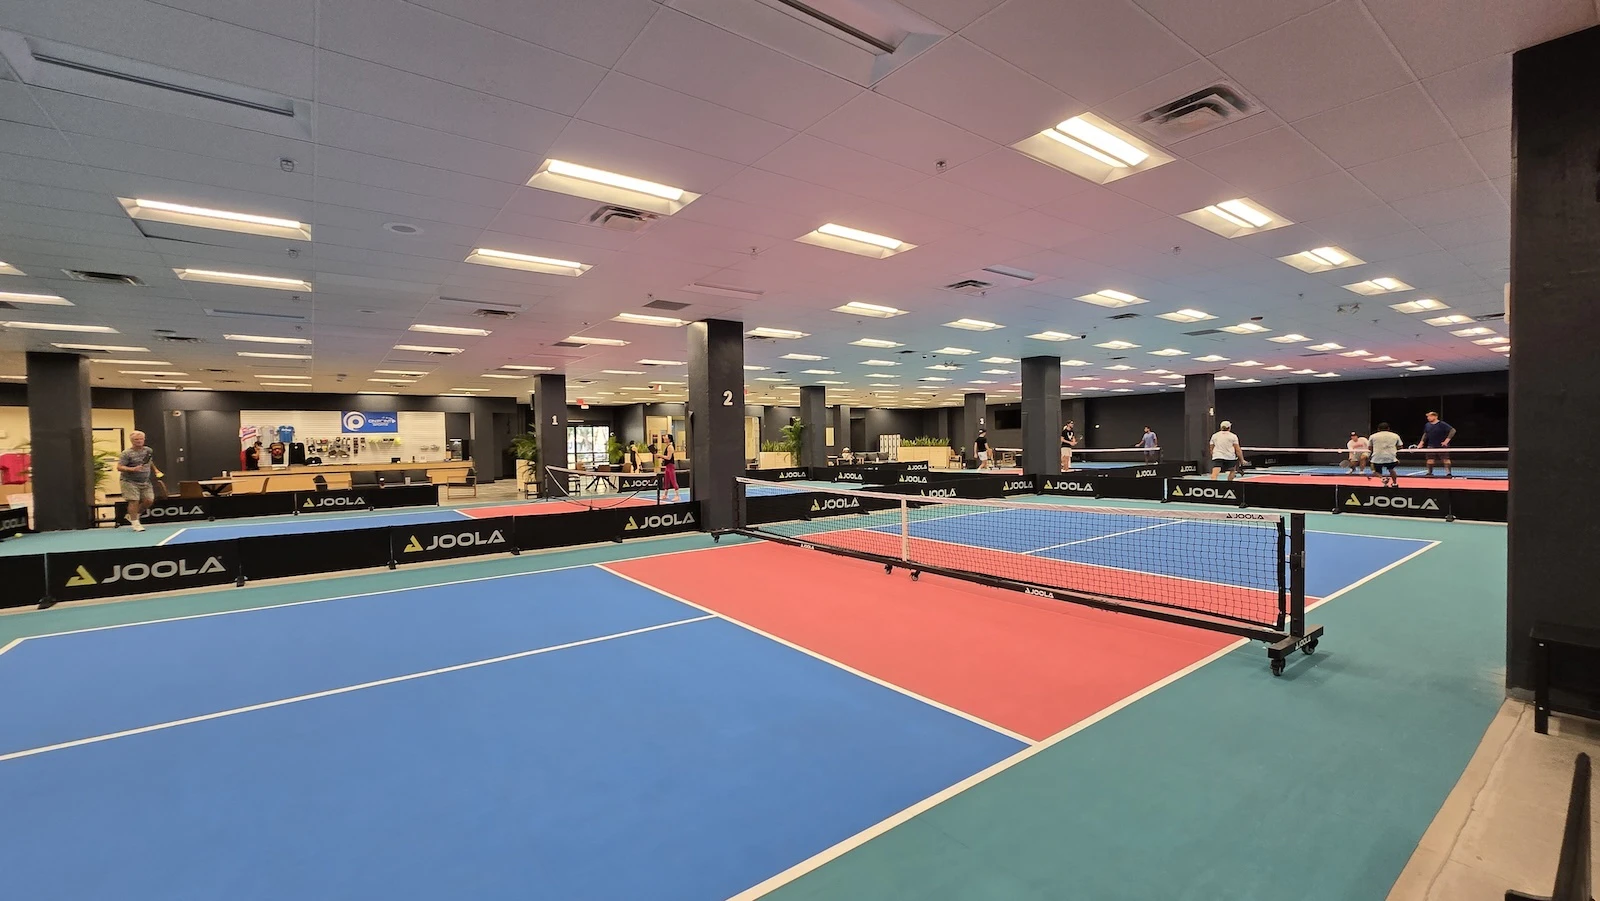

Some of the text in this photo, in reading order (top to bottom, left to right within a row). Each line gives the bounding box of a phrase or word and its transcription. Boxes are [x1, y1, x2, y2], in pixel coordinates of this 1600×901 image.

[723, 390, 733, 406] 2
[551, 415, 558, 425] 1
[784, 471, 807, 479] JOOLA
[843, 472, 863, 480] JOOLA
[1140, 469, 1157, 477] JOOLA
[630, 479, 659, 488] JOOLA
[904, 475, 928, 484] JOOLA
[1009, 480, 1033, 490] JOOLA
[1053, 481, 1094, 492] JOOLA
[1184, 487, 1237, 500] JOOLA
[315, 496, 366, 507] JOOLA
[820, 497, 861, 511] JOOLA
[1362, 495, 1440, 511] JOOLA
[139, 505, 205, 519] JOOLA
[639, 511, 696, 530] JOOLA
[425, 529, 506, 551] JOOLA
[101, 556, 227, 584] JOOLA
[1030, 588, 1055, 599] JOOLA
